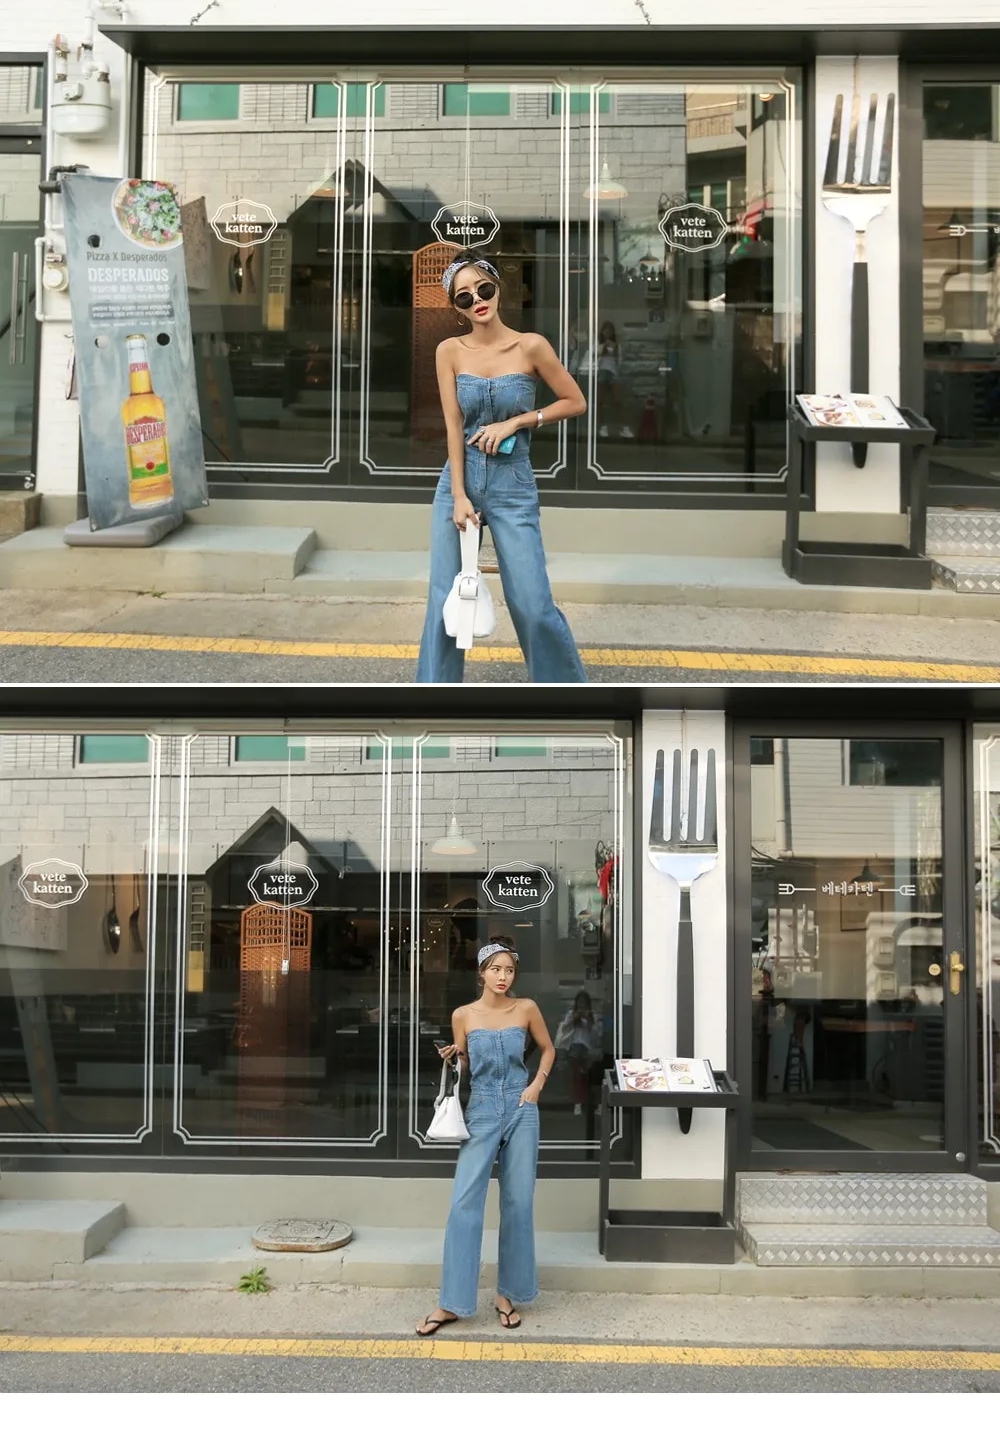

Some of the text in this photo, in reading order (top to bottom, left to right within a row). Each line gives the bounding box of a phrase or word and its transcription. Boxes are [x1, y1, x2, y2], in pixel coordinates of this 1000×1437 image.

[232, 213, 257, 222] vete
[453, 215, 479, 224] vete
[680, 217, 706, 227] vete
[225, 221, 263, 233] katten
[446, 223, 486, 235] katten
[673, 225, 713, 238] katten
[86, 251, 110, 261] Pizza
[121, 252, 168, 263] Desperados
[87, 267, 170, 282] DESPERADOS
[40, 873, 67, 882] vete
[270, 874, 297, 883] vete
[505, 875, 532, 885] vete
[33, 881, 73, 894] katten
[263, 883, 303, 895] katten
[498, 884, 538, 897] katten
